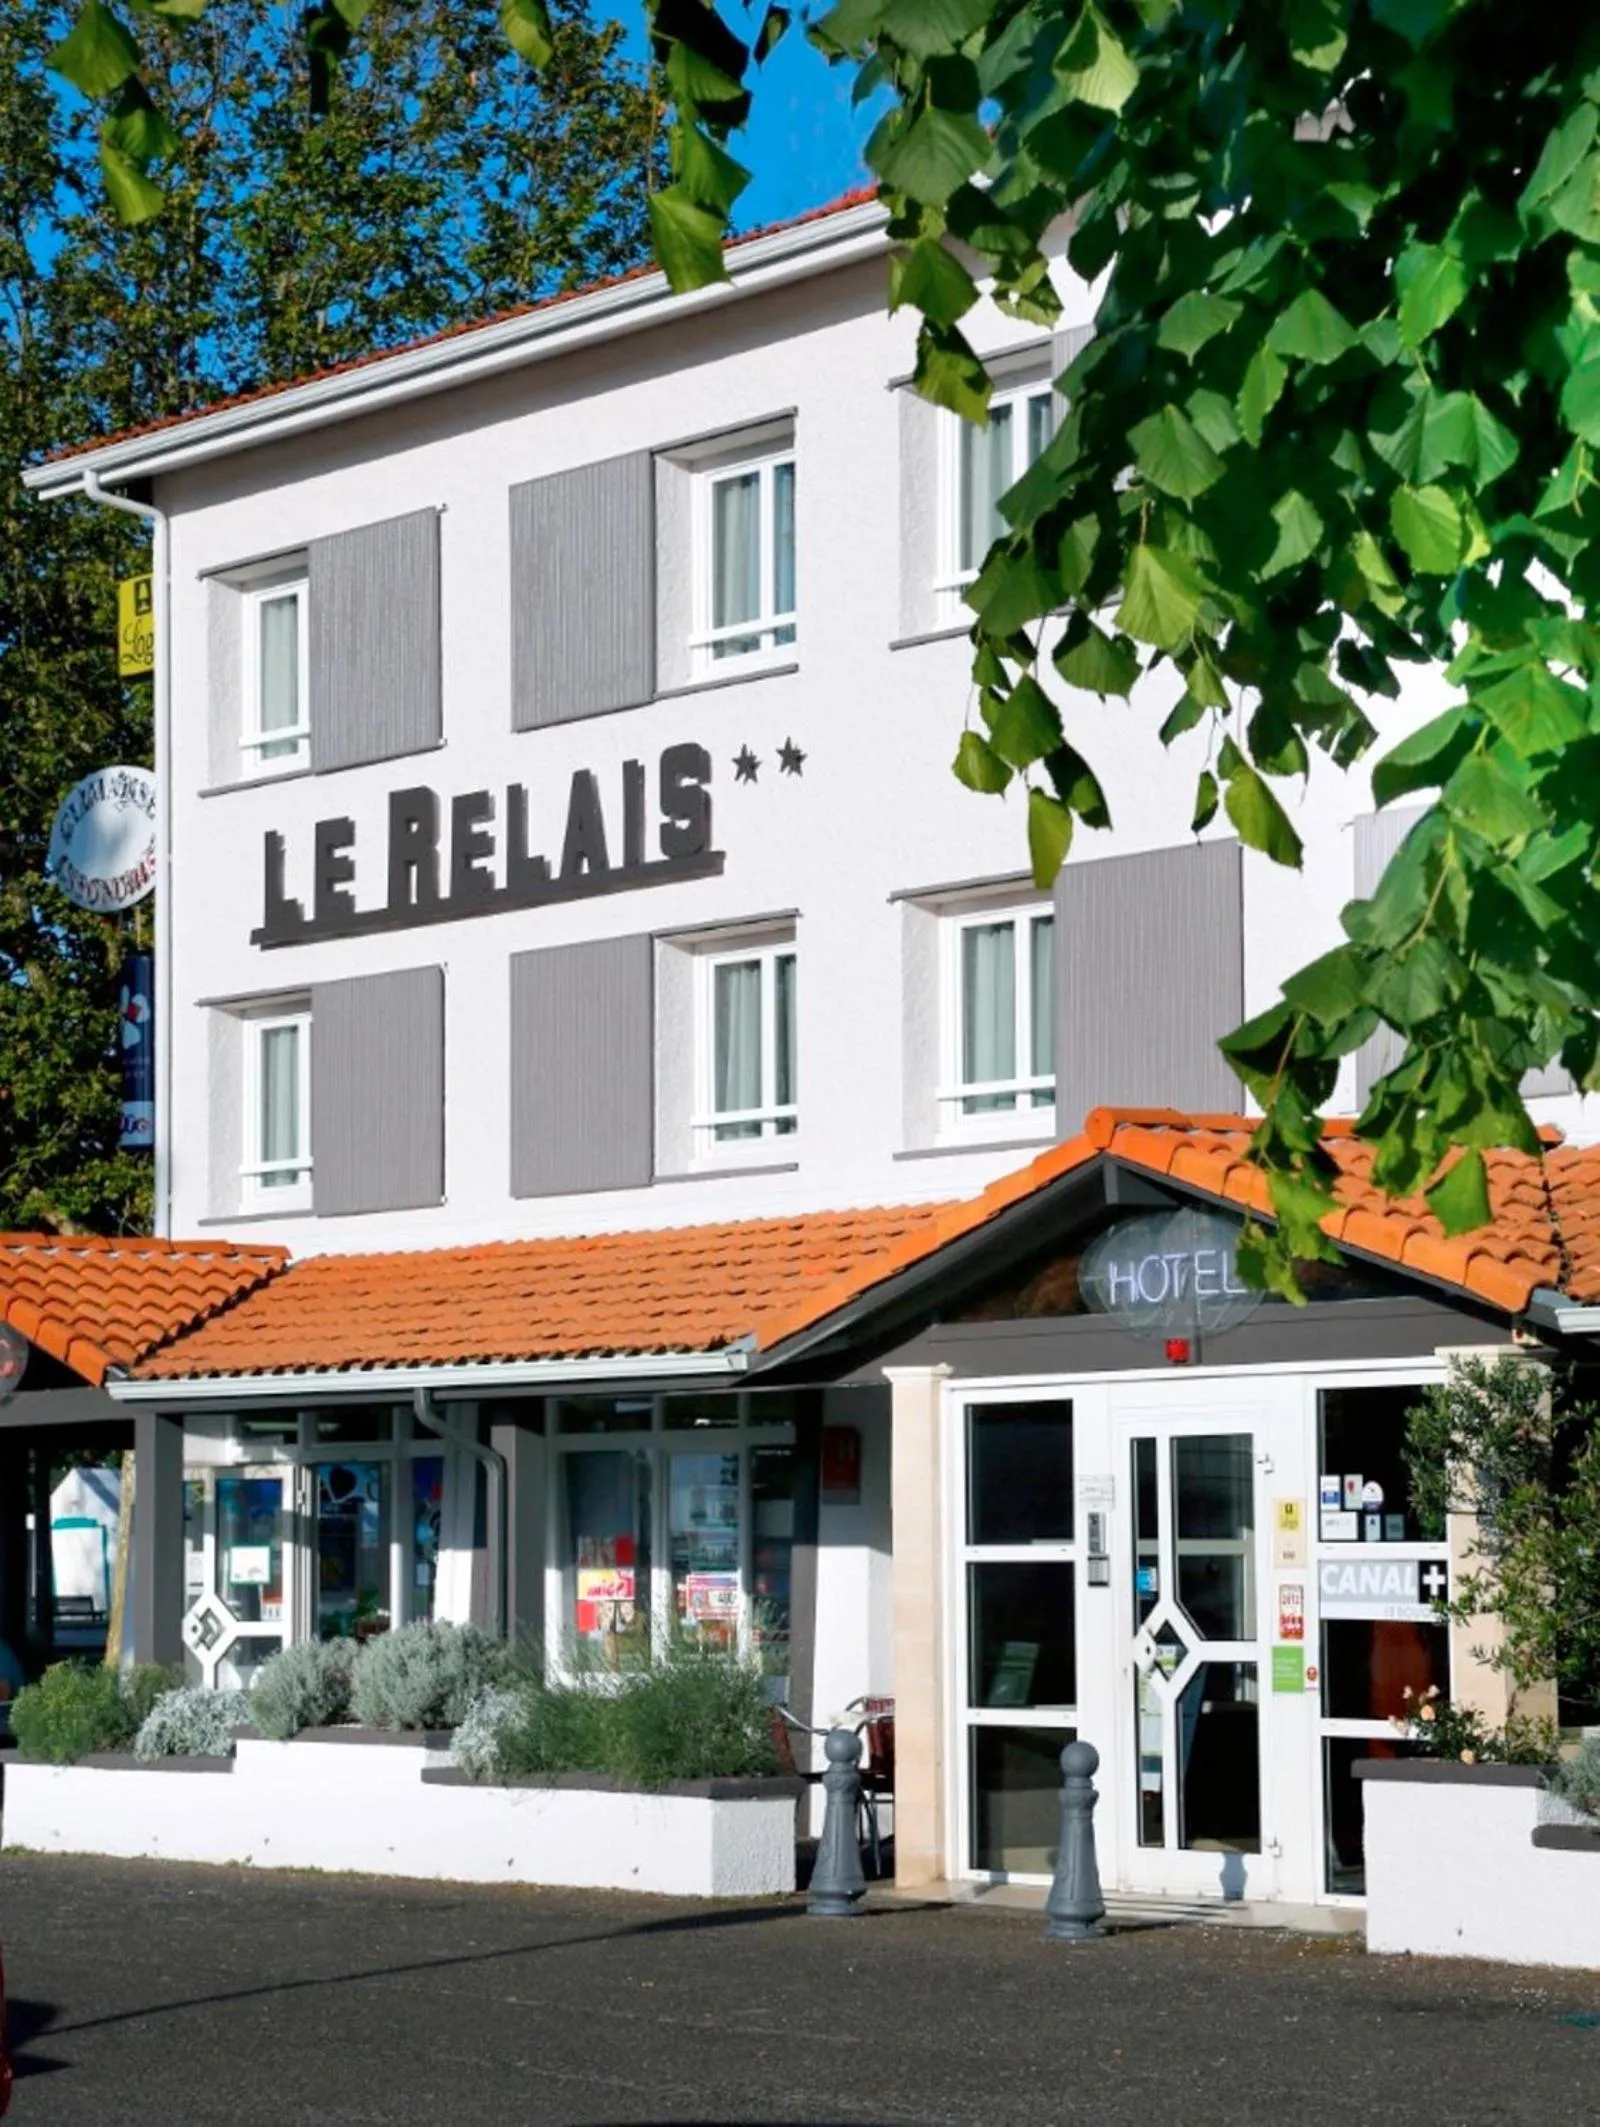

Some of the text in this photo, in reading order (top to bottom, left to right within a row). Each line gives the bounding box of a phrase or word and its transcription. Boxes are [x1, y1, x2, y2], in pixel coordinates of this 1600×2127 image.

[264, 742, 713, 922] LE RELAIS
[1109, 1250, 1247, 1304] HOTEL
